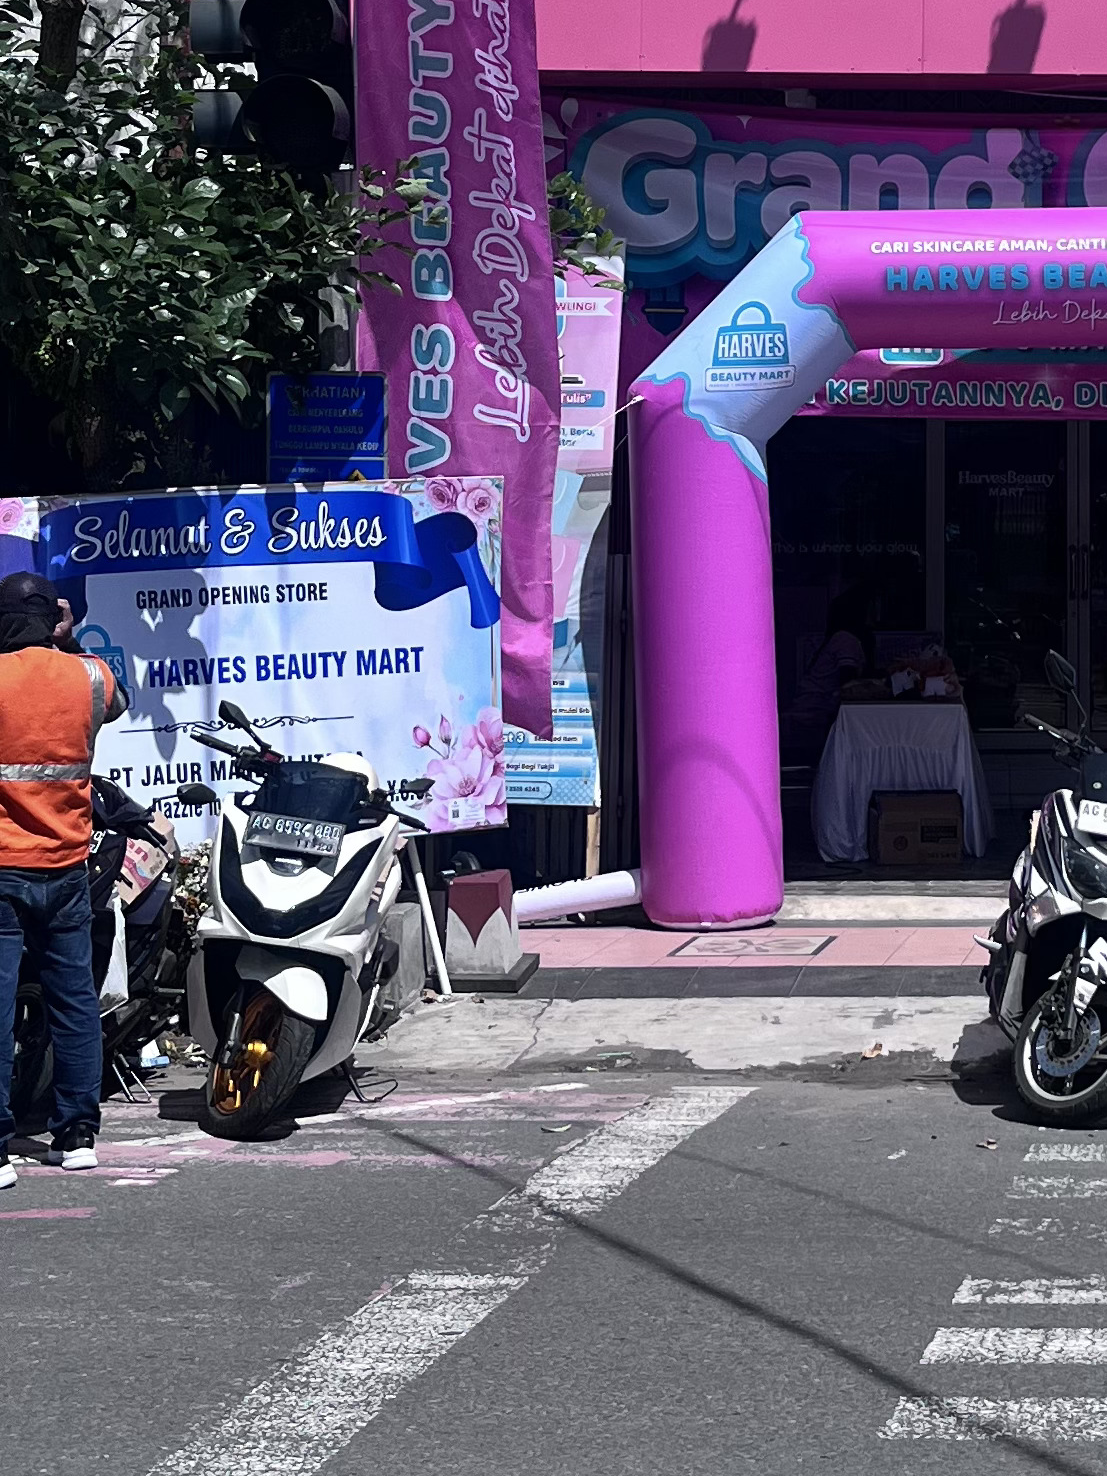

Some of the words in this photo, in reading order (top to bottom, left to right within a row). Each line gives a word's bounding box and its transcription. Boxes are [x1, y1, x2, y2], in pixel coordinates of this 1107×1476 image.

[464, 108, 535, 282] Dekat
[577, 116, 1028, 256] Grand
[870, 241, 909, 254] CARI
[912, 239, 995, 253] SKINCARE
[998, 239, 1053, 252] AMAN,
[886, 263, 1030, 291] HARVES
[555, 301, 597, 311] WLINGI
[992, 299, 1057, 326] Lebih
[718, 333, 785, 358] HARVES
[472, 279, 530, 442] Lebih
[711, 372, 756, 382] BEAUTY
[759, 370, 790, 381] MART
[826, 379, 1064, 411] KEJUTANNYA,
[989, 488, 1025, 497] MART
[71, 511, 213, 563] Selamat
[221, 508, 255, 554] &
[267, 501, 387, 554] Sukses
[136, 587, 193, 610] GRAND
[198, 585, 272, 607] OPENING
[276, 582, 328, 604] STORE
[148, 656, 246, 688] HARVES
[256, 651, 345, 683] BEAUTY
[356, 646, 425, 676] MART
[109, 766, 134, 788] PT
[141, 762, 203, 786] JALUR
[252, 815, 272, 830] AG
[1082, 803, 1100, 816] AG
